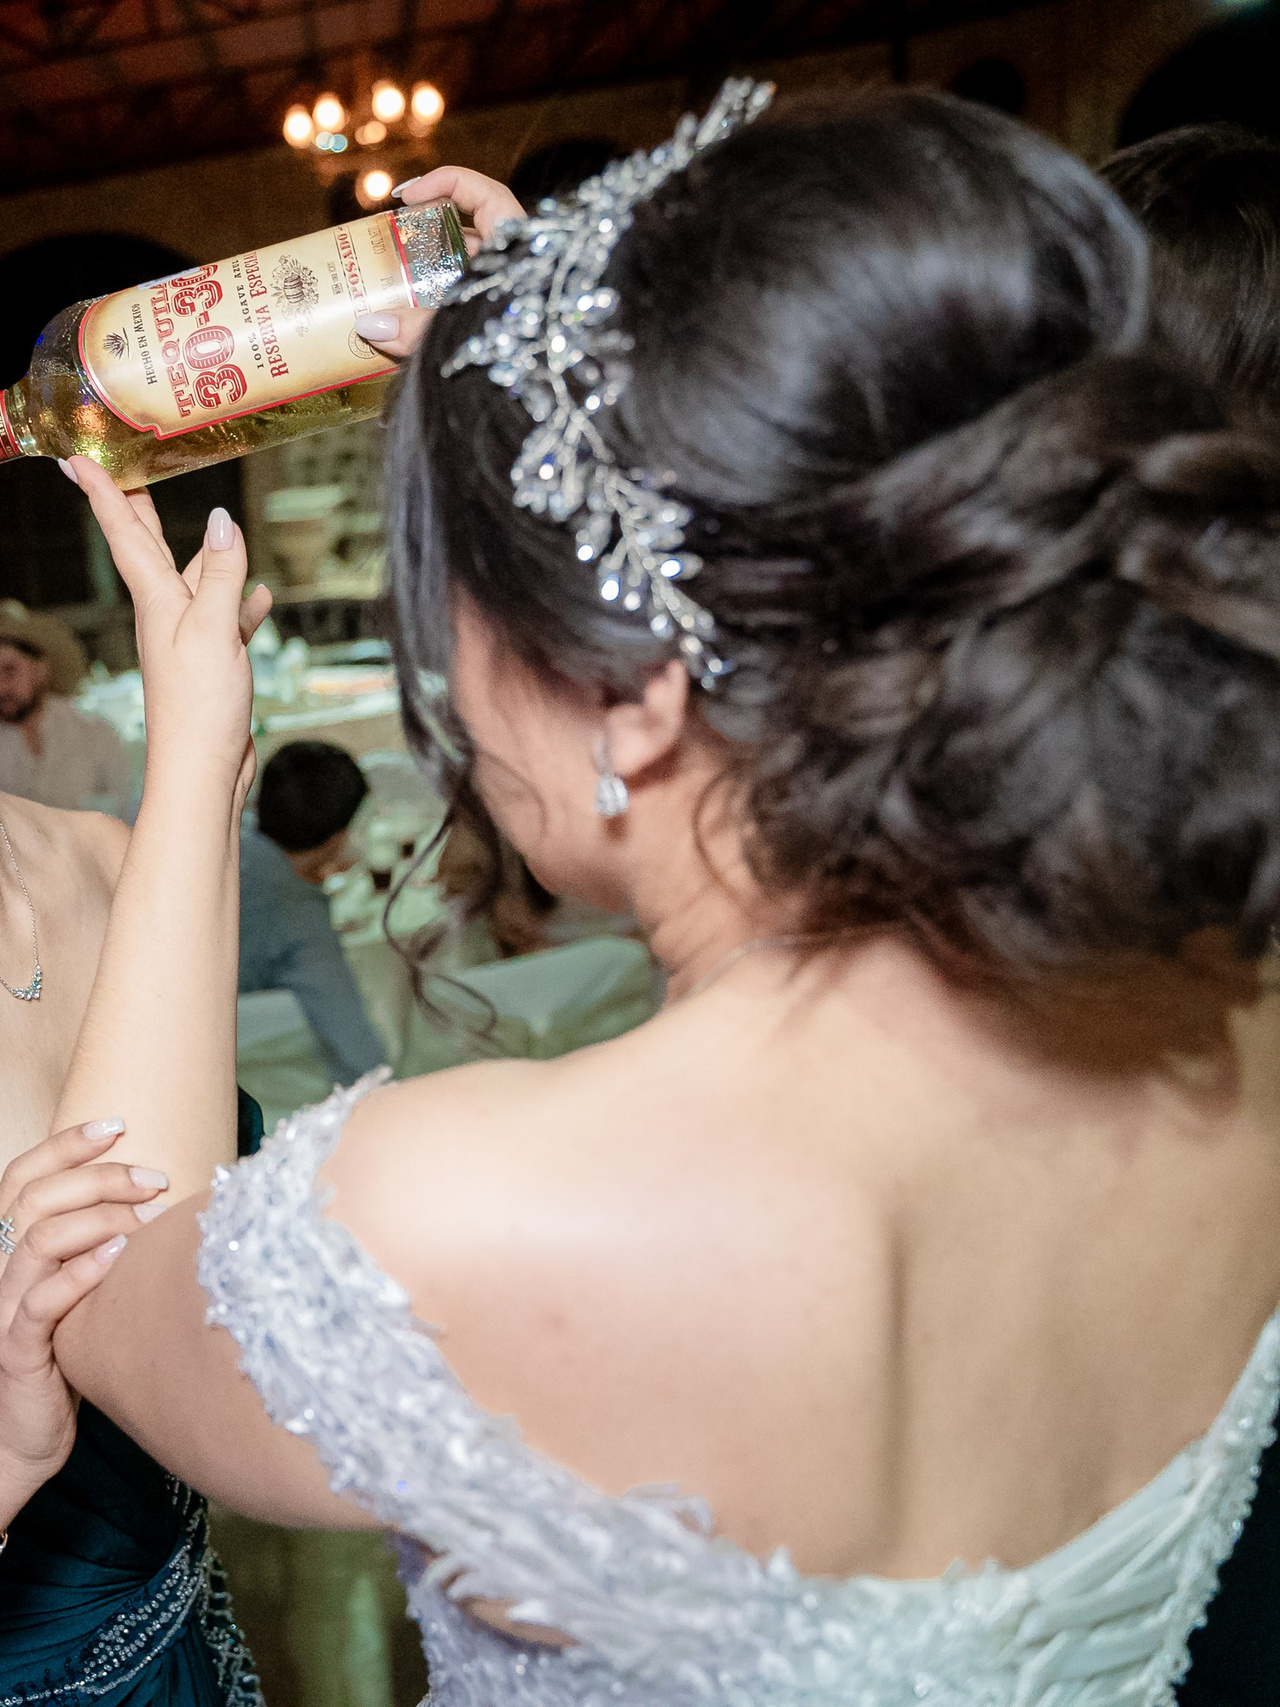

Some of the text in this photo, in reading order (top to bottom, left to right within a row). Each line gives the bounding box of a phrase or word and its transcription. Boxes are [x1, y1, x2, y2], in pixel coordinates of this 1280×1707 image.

[236, 284, 253, 324] AGAVE
[137, 333, 148, 349] EN
[168, 264, 248, 410] 30-30
[248, 331, 265, 369] 100%
[255, 304, 289, 379] RESERVA
